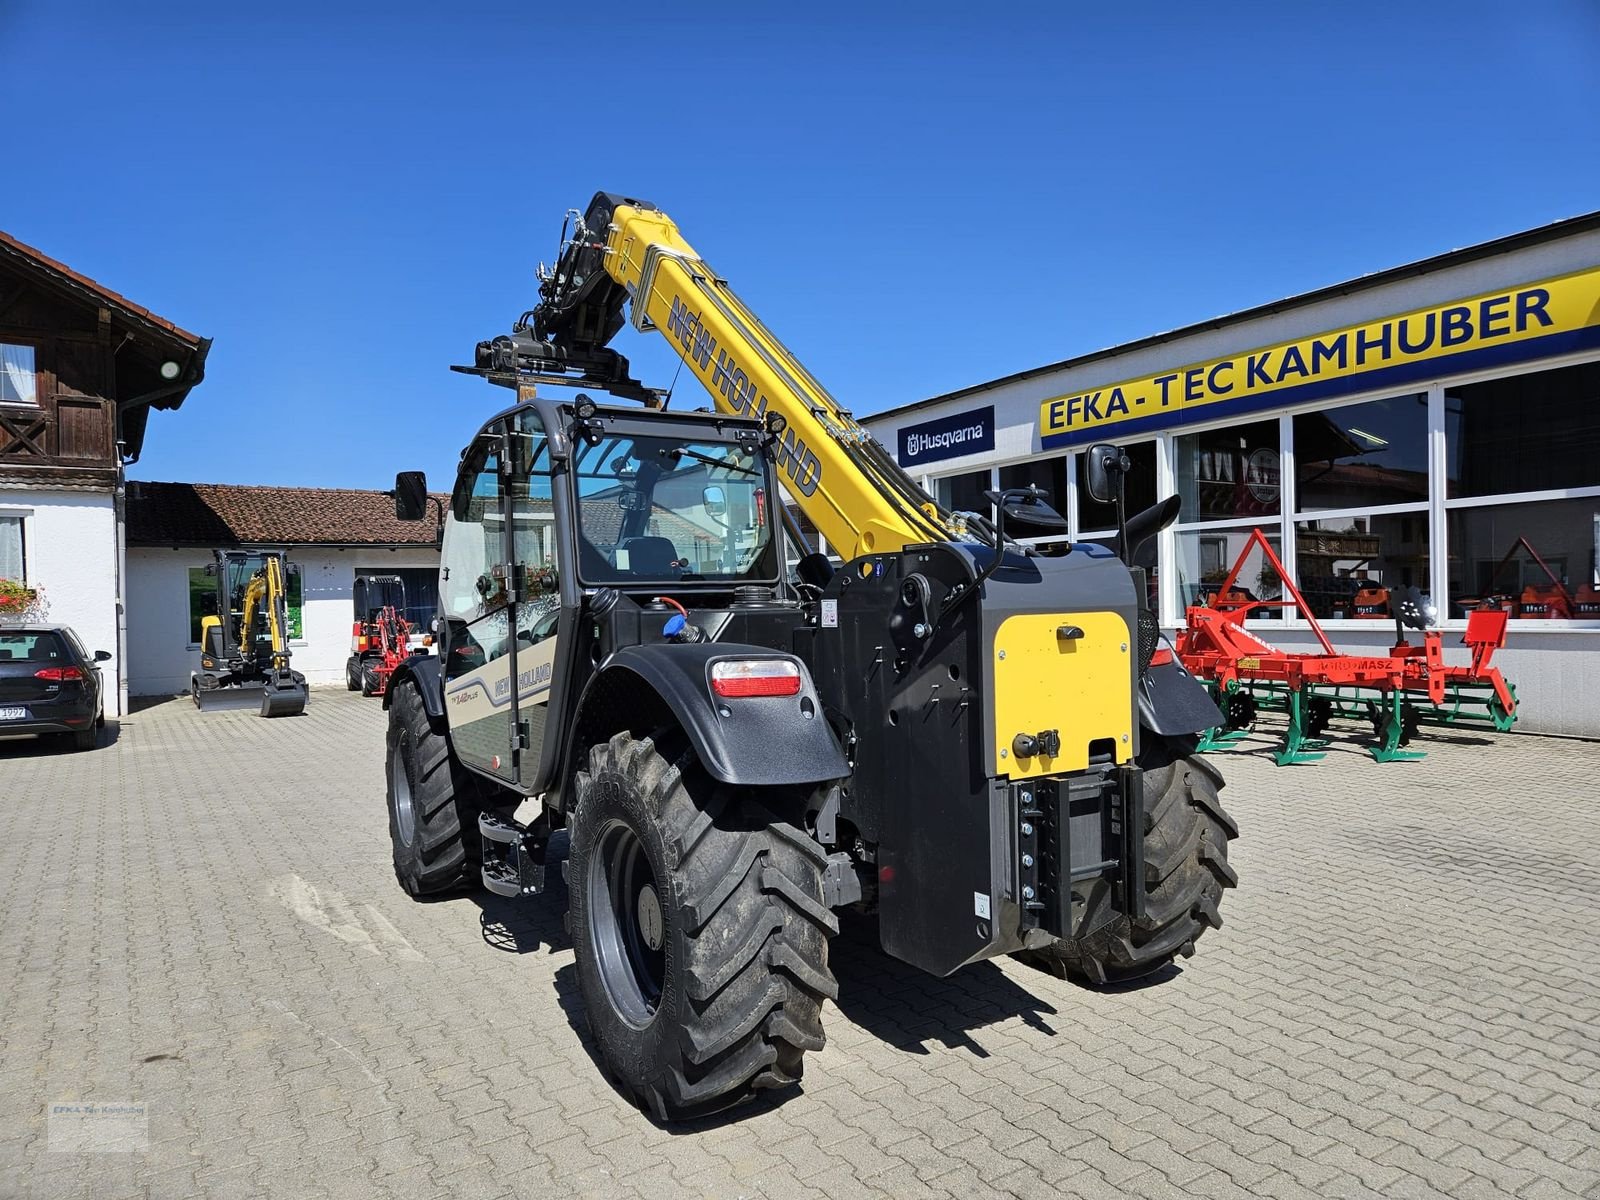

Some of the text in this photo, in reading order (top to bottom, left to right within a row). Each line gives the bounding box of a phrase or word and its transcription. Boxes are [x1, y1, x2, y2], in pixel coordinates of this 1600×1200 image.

[667, 294, 822, 497] NEW HOLND
[1050, 388, 1130, 429] EFKA
[1154, 362, 1234, 406] TEC
[1247, 288, 1554, 388] KAMHUBER
[920, 424, 983, 451] Husqvarna
[495, 662, 551, 698] NEW HOLLAND
